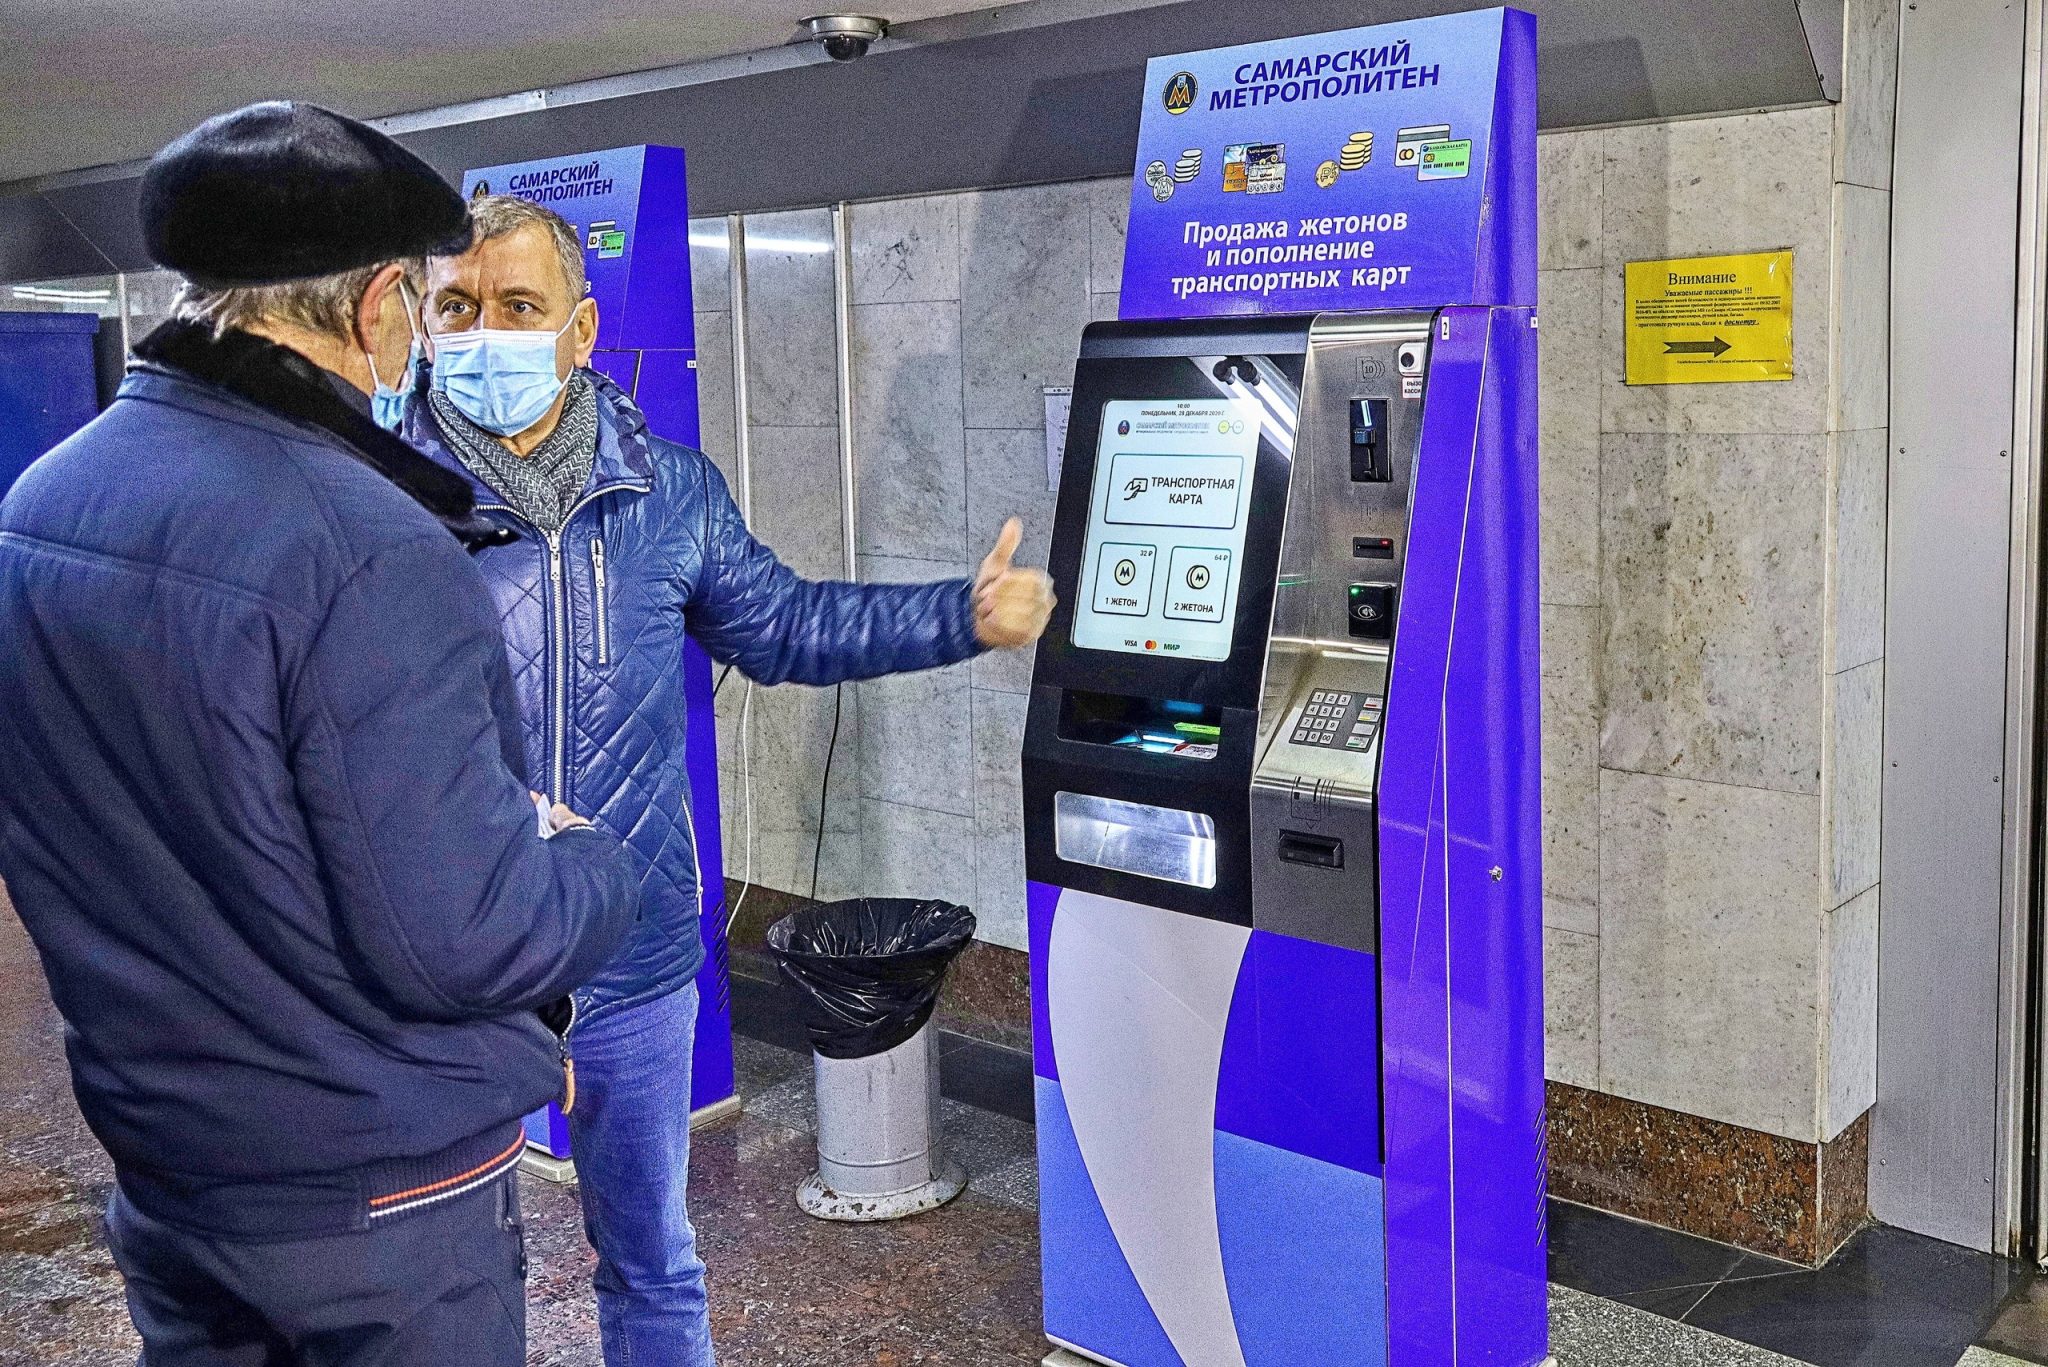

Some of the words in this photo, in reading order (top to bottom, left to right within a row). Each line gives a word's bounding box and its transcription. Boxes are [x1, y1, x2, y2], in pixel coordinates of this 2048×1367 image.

[1234, 39, 1411, 84] САМАРСКИЙ
[1208, 64, 1440, 111] МЕТРОПОЛИТЕН
[509, 160, 600, 190] САМАРСКИЙ
[510, 178, 613, 203] ТРОПОЛИТЕН
[1183, 218, 1288, 248] Продажа
[1298, 212, 1408, 237] жетонов
[1206, 248, 1221, 267] и
[1225, 239, 1375, 266] пополнение
[1171, 268, 1340, 299] транспортных
[1351, 264, 1411, 293] карт
[1668, 273, 1736, 285] Внимание
[1665, 289, 1703, 297] Уважаемые
[1705, 289, 1743, 297] пассажиры
[1443, 322, 1448, 335] 2
[1151, 476, 1235, 490] ТРАНСПОРТНАЯ
[1168, 493, 1203, 505] КАРТА
[1105, 597, 1109, 606] 1
[1110, 597, 1138, 607] ЖЕТОН
[1174, 602, 1179, 611] 2
[1180, 603, 1214, 614] ЖЕТОНА
[1124, 639, 1138, 648] VISA
[1163, 642, 1180, 651] МИР
